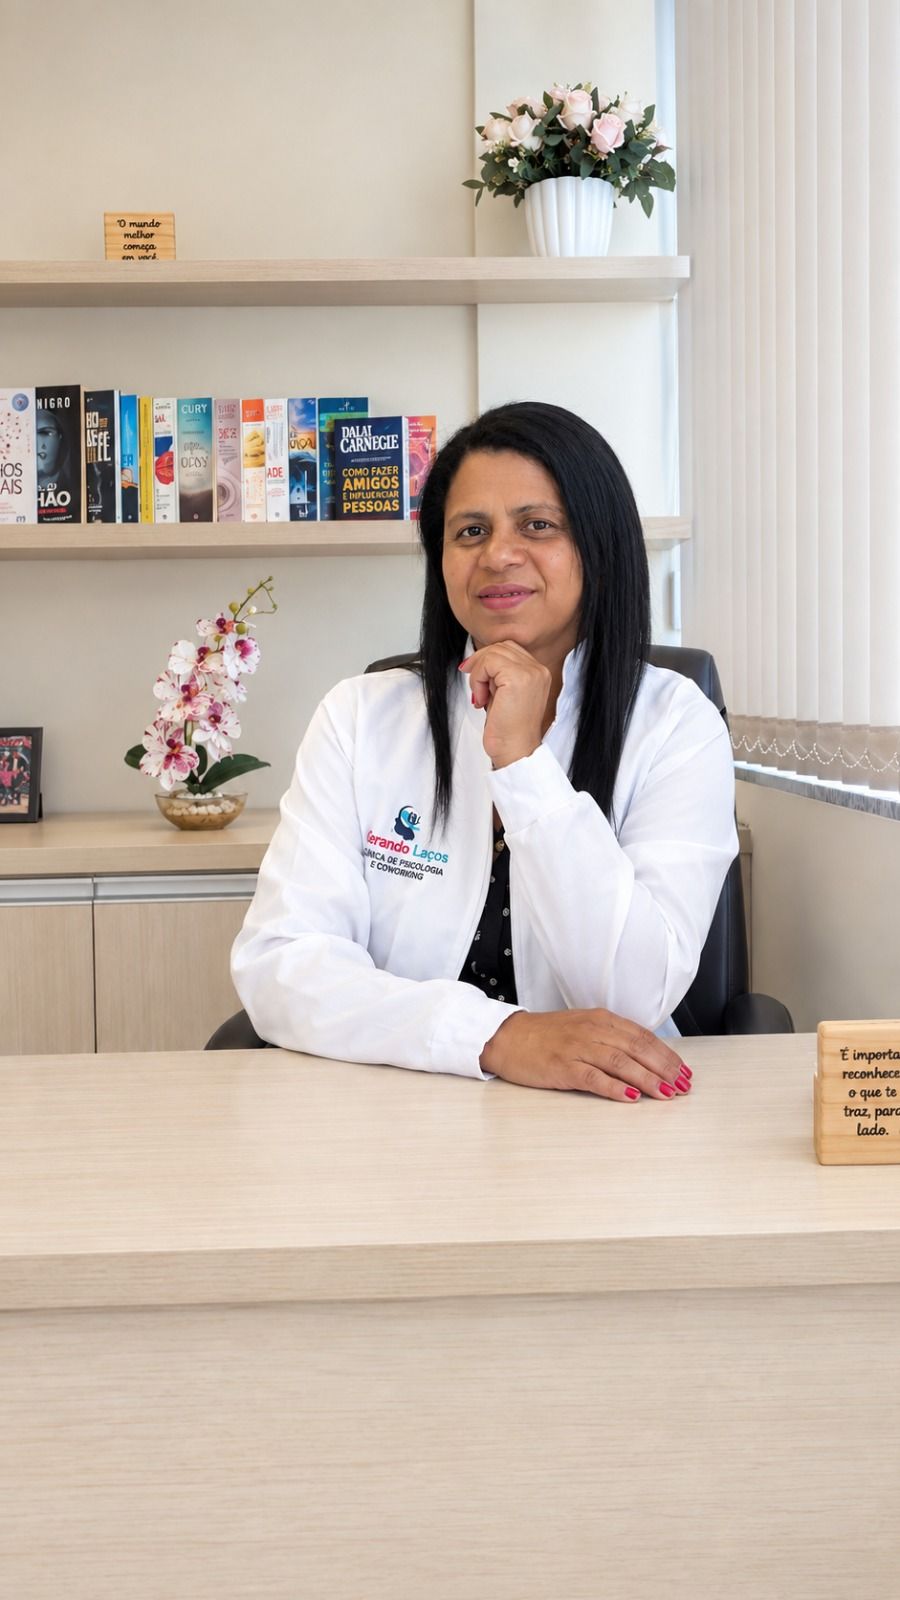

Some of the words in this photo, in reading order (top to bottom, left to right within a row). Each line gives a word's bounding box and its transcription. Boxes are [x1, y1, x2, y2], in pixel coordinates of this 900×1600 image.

[129, 219, 162, 228] mundo
[124, 230, 155, 239] melhor
[123, 243, 157, 253] começa
[37, 397, 71, 410] NIGRO
[181, 404, 208, 414] CURY
[340, 434, 399, 453] CARNEGIE
[342, 467, 369, 477] COMO
[371, 465, 399, 475] FAZER
[343, 476, 399, 491] AMIGOS
[342, 492, 348, 500] E
[343, 499, 399, 513] PESSOAS
[412, 844, 449, 863] Laços
[370, 860, 376, 868] E
[376, 863, 424, 880] COWORKING
[387, 856, 398, 865] DE
[399, 859, 444, 876] PSICOLOGIA
[853, 1049, 900, 1064] importa
[848, 1089, 857, 1098] o
[859, 1089, 882, 1101] que
[885, 1086, 897, 1097] te
[843, 1106, 871, 1119] traz,
[857, 1122, 889, 1136] lado.
